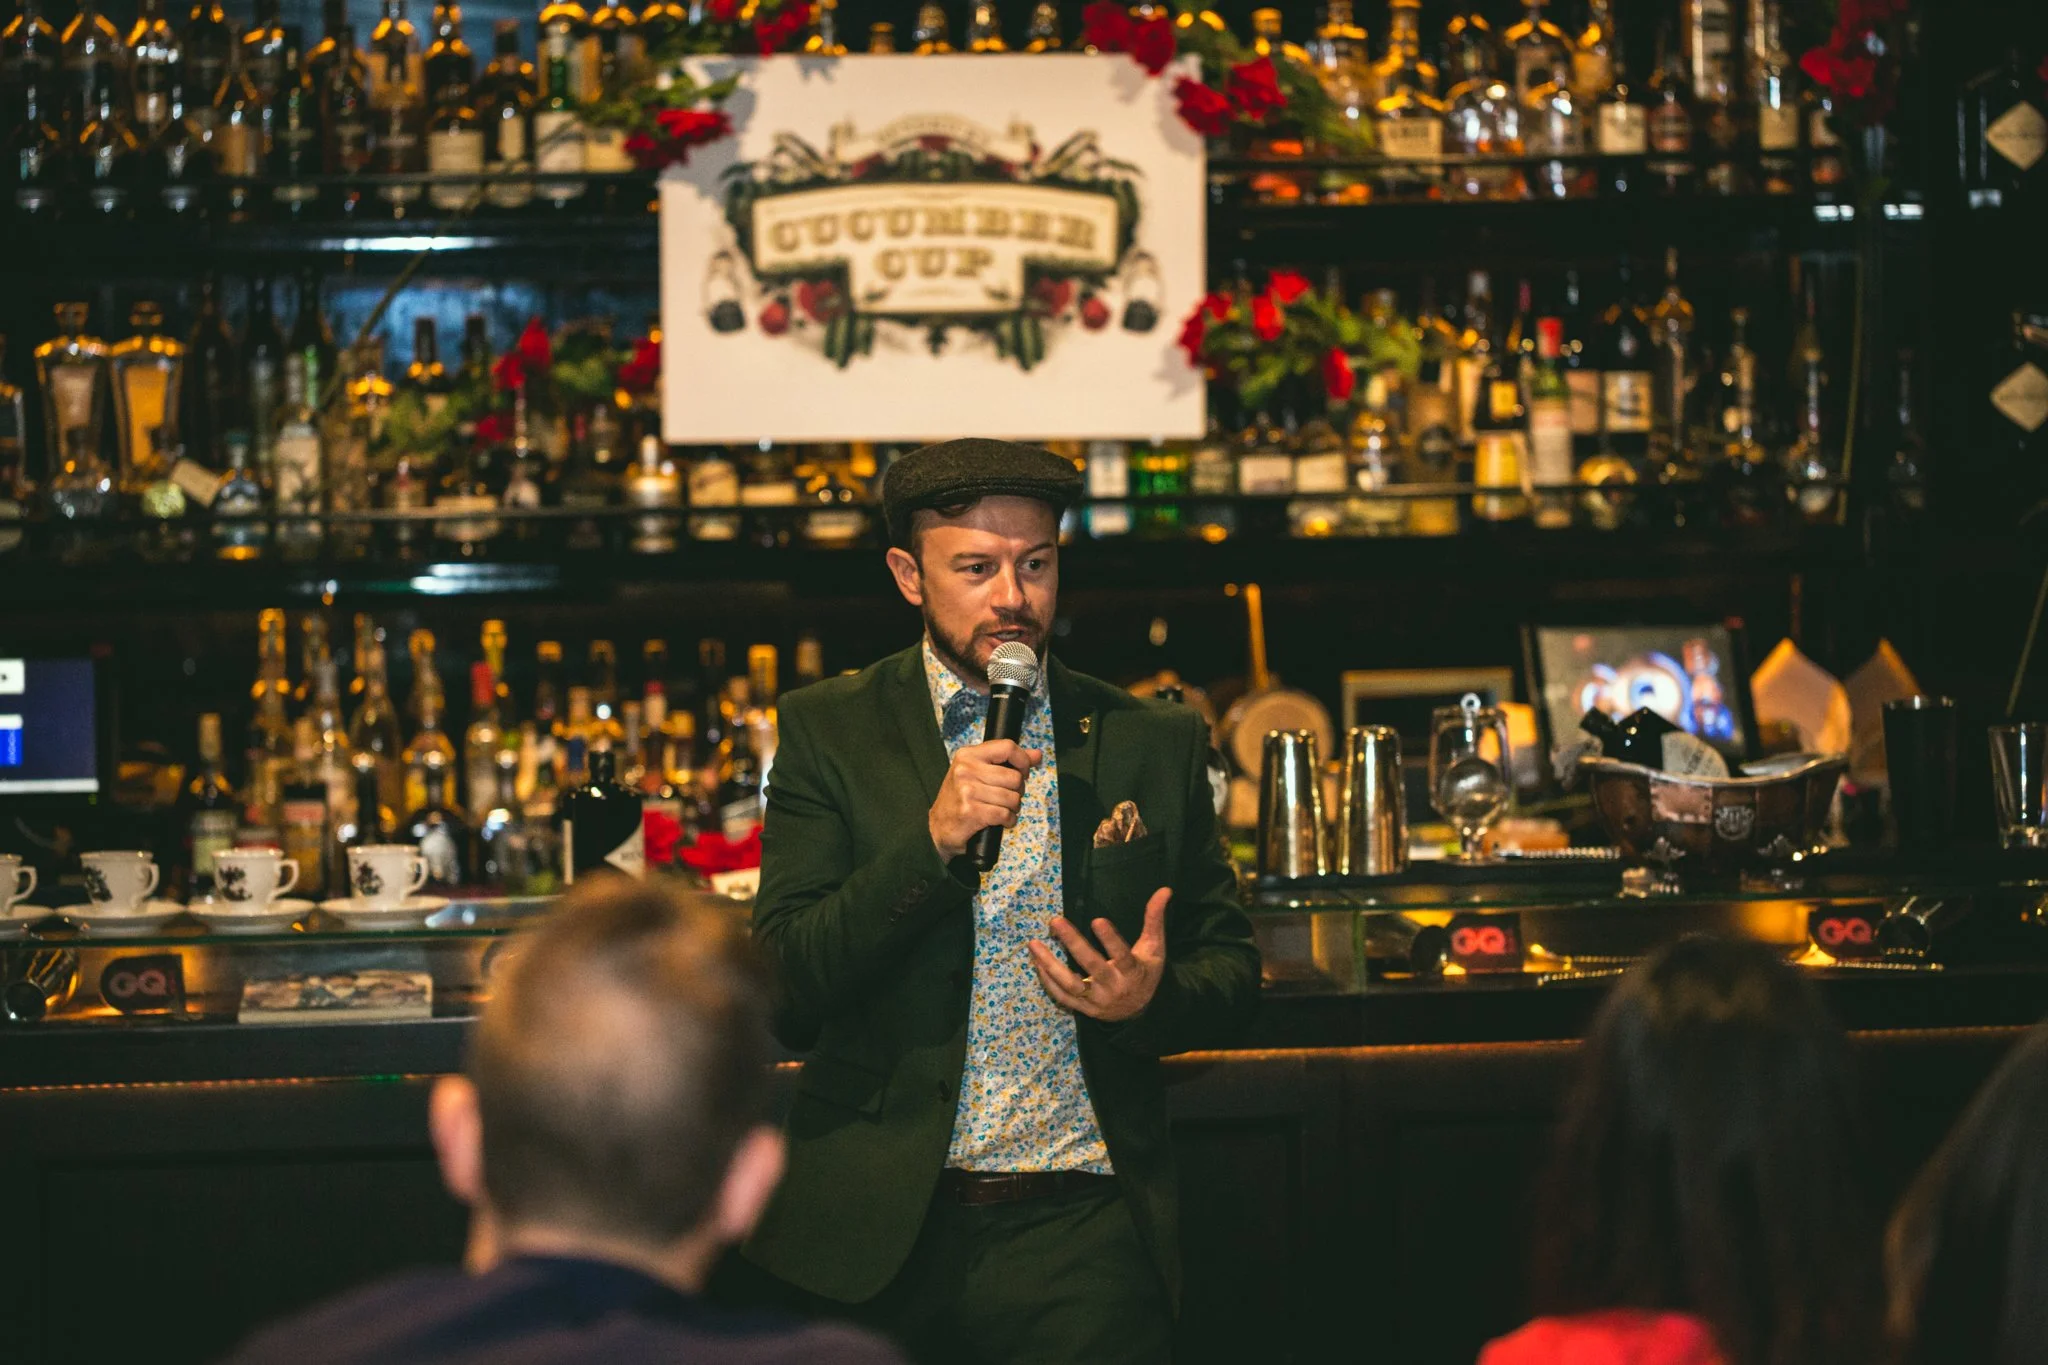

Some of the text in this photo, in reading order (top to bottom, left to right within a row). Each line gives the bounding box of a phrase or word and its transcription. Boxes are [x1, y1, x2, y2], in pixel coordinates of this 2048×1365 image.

[768, 207, 1097, 252] CUCUMBER
[875, 248, 995, 281] CUP
[1451, 926, 1506, 955] GQ
[1818, 917, 1873, 945] GQ
[109, 969, 168, 997] GQ
